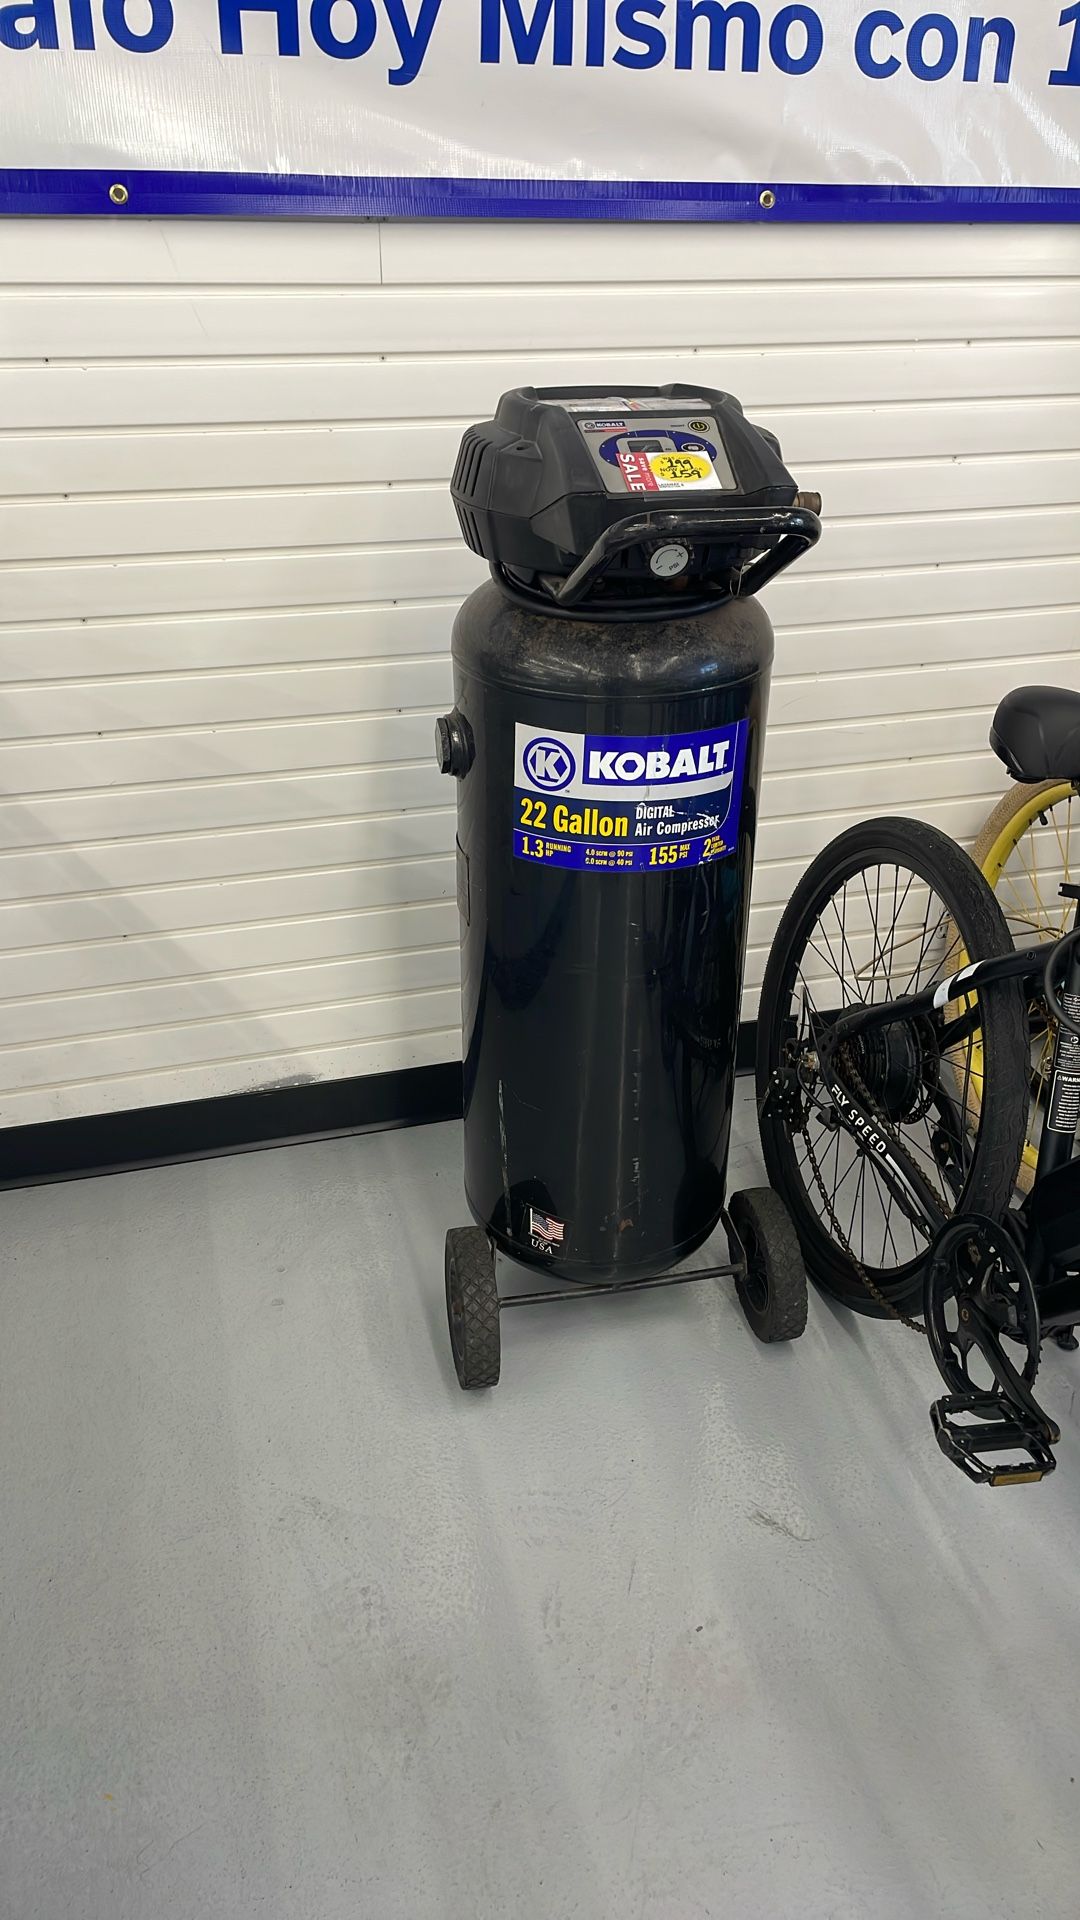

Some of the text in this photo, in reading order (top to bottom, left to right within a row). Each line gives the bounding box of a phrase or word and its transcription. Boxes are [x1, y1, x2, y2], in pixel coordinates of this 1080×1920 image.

[218, 0, 443, 86] Hoy
[480, 0, 824, 76] Mismo
[854, 9, 1016, 84] con
[620, 454, 647, 491] SALE
[667, 457, 694, 469] 199
[671, 469, 702, 478] 159
[588, 740, 730, 780] KOBALT
[520, 798, 629, 837] 22 Gallon
[635, 804, 675, 820] DIGITAL
[634, 814, 720, 837] Air Compressor
[522, 836, 572, 858] 1.3 RUNNING
[545, 849, 554, 857] HP
[649, 843, 690, 865] 155 MAX
[703, 838, 712, 857] 2
[831, 1084, 887, 1153] FLY SPEED
[531, 1239, 553, 1255] USA
